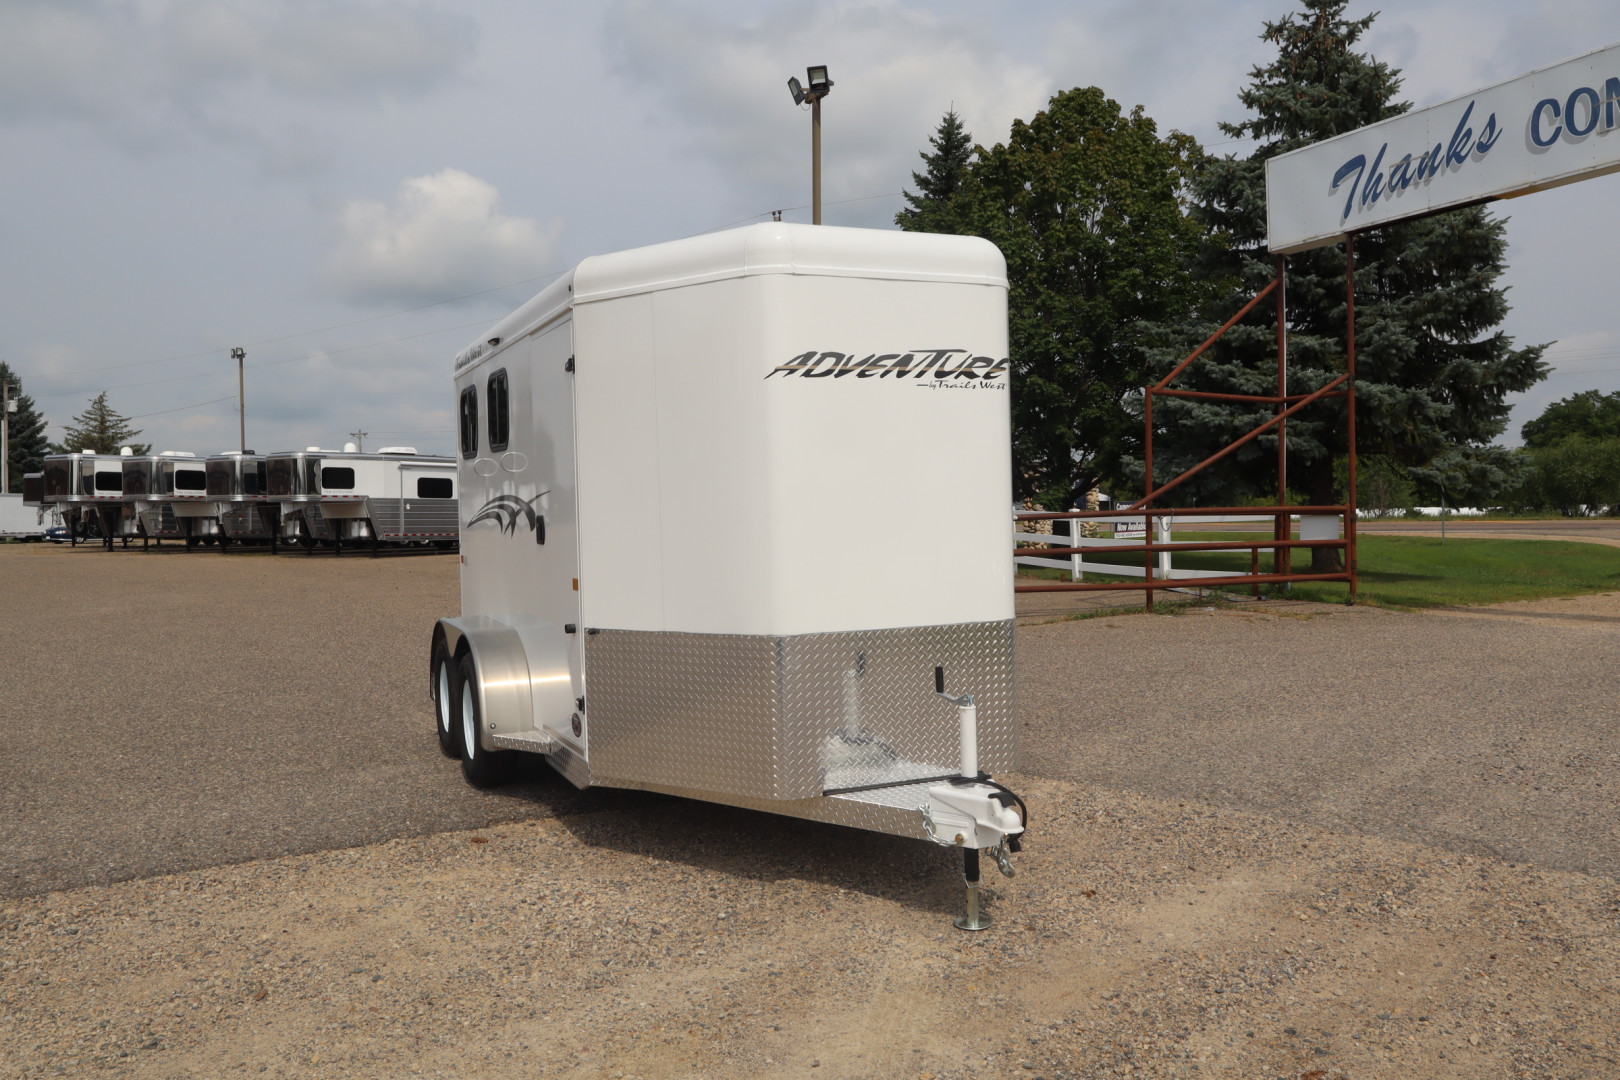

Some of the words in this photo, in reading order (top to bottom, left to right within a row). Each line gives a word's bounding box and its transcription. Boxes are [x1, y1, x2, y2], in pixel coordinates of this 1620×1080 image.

[1331, 100, 1503, 220] Thanks
[764, 349, 1010, 380] ADVENTURE
[935, 380, 977, 390] Trails
[979, 381, 1006, 390] West
